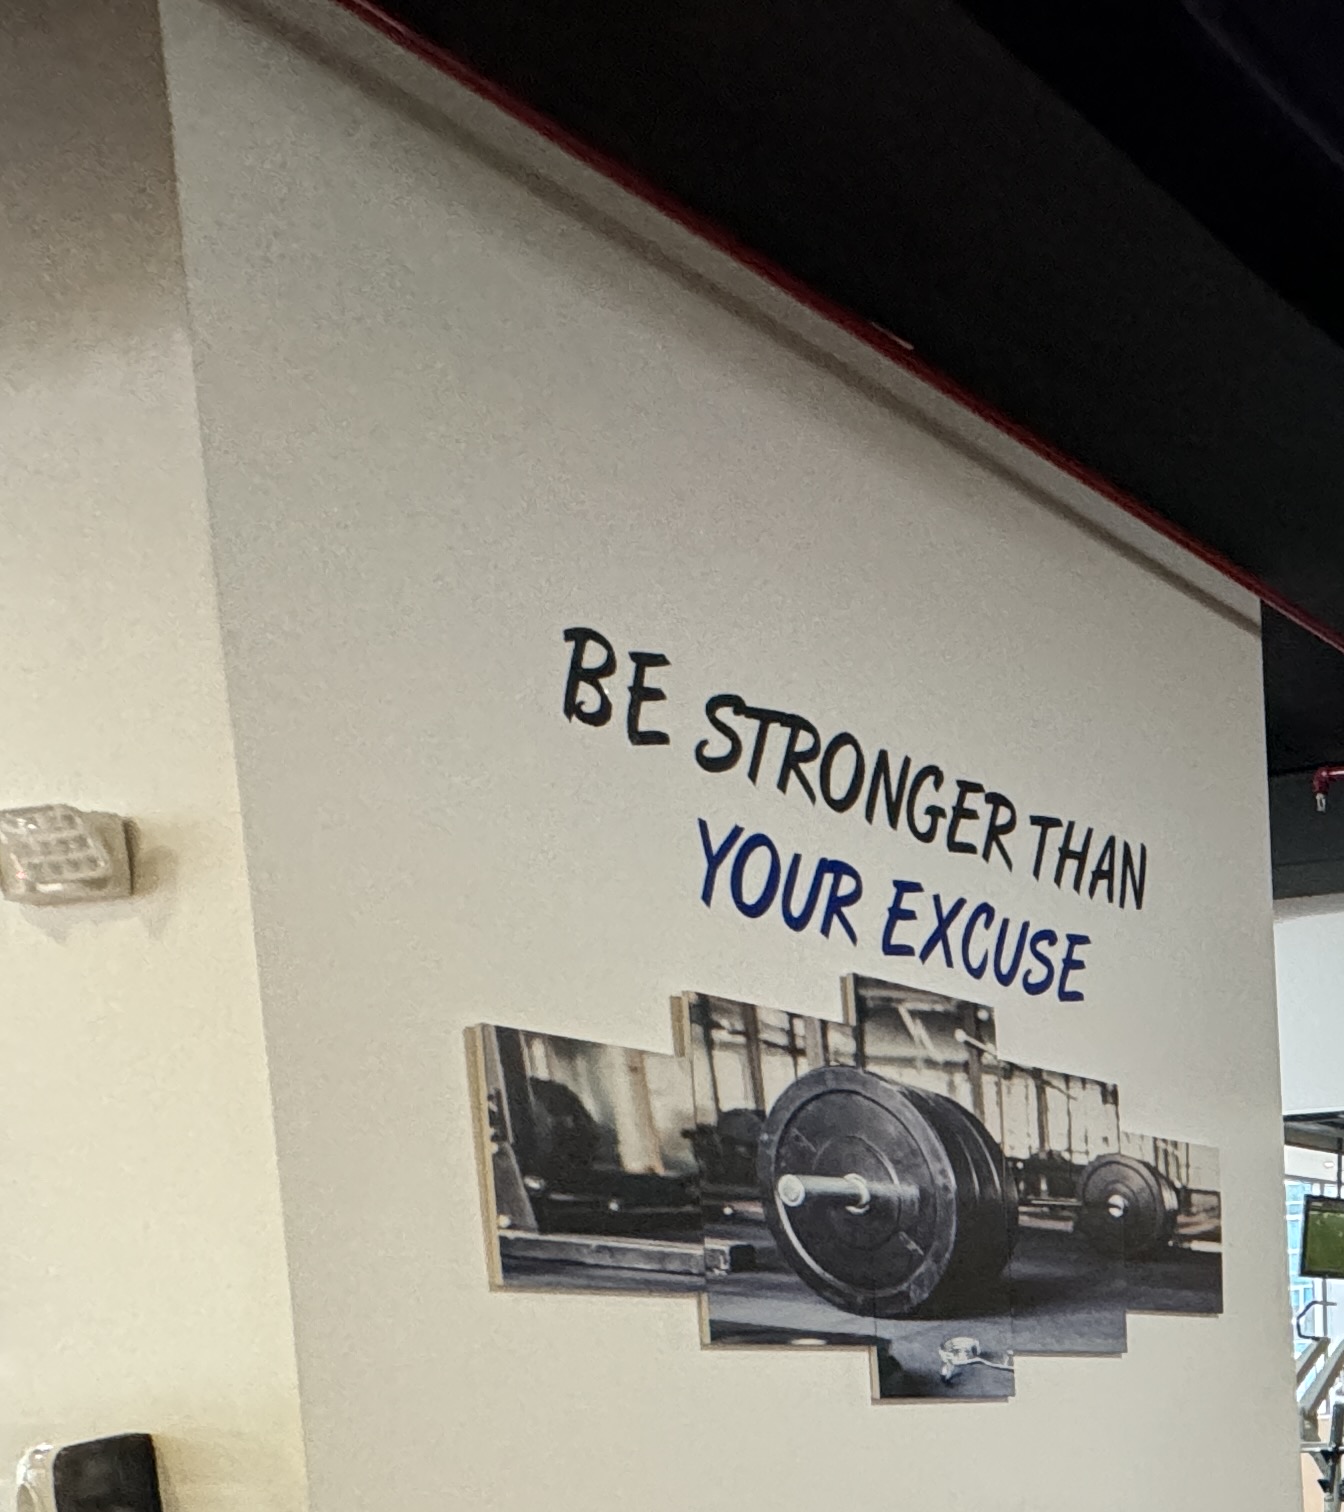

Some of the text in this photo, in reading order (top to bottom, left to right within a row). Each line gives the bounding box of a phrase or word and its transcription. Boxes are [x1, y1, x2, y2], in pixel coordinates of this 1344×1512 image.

[563, 627, 1147, 911] BE STRONGER THAN
[697, 817, 1092, 1003] YOUR EXCUSE
